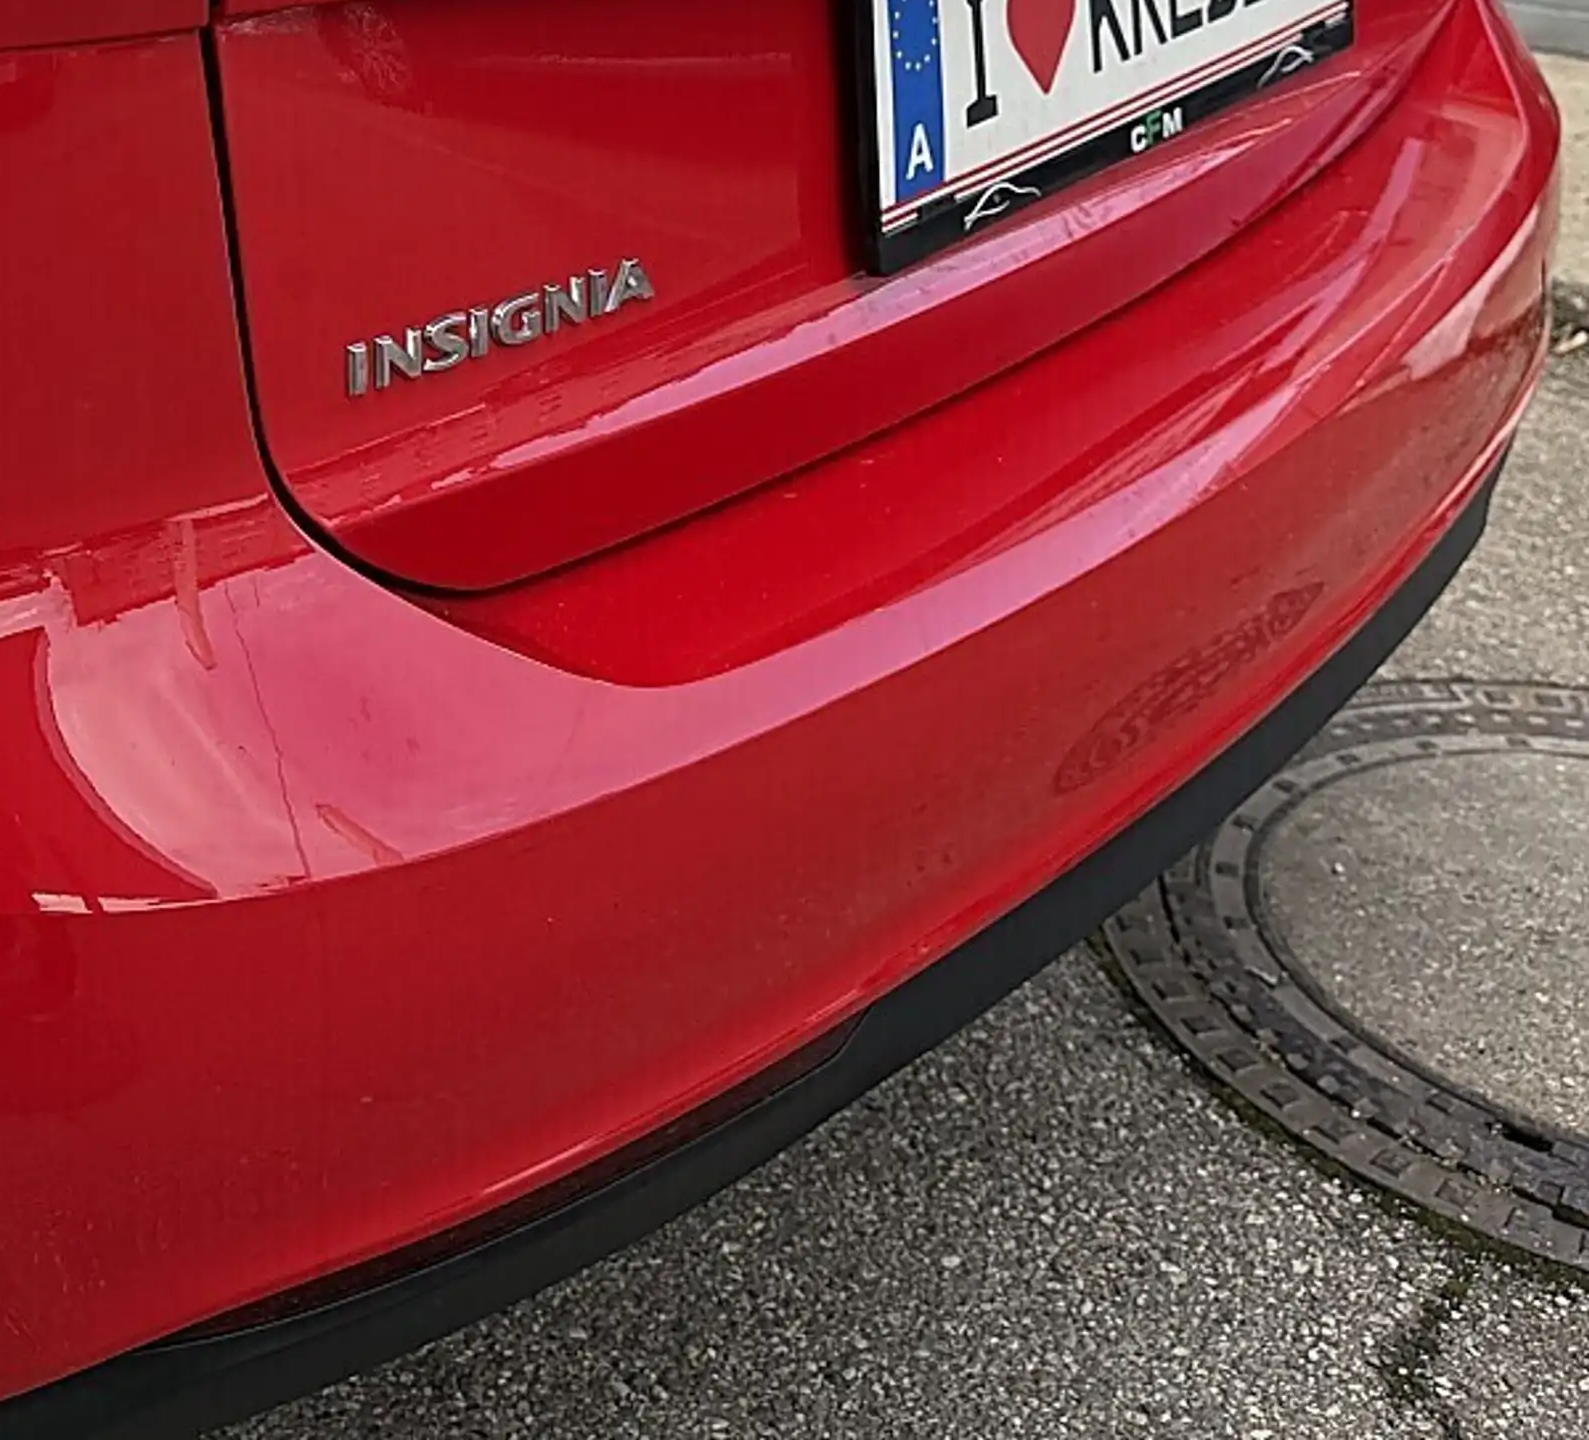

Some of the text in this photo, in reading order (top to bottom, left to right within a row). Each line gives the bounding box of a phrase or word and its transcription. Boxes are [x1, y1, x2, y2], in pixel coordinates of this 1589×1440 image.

[906, 123, 934, 180] A
[1130, 106, 1183, 153] CFM
[346, 257, 655, 397] INSIGNIA
